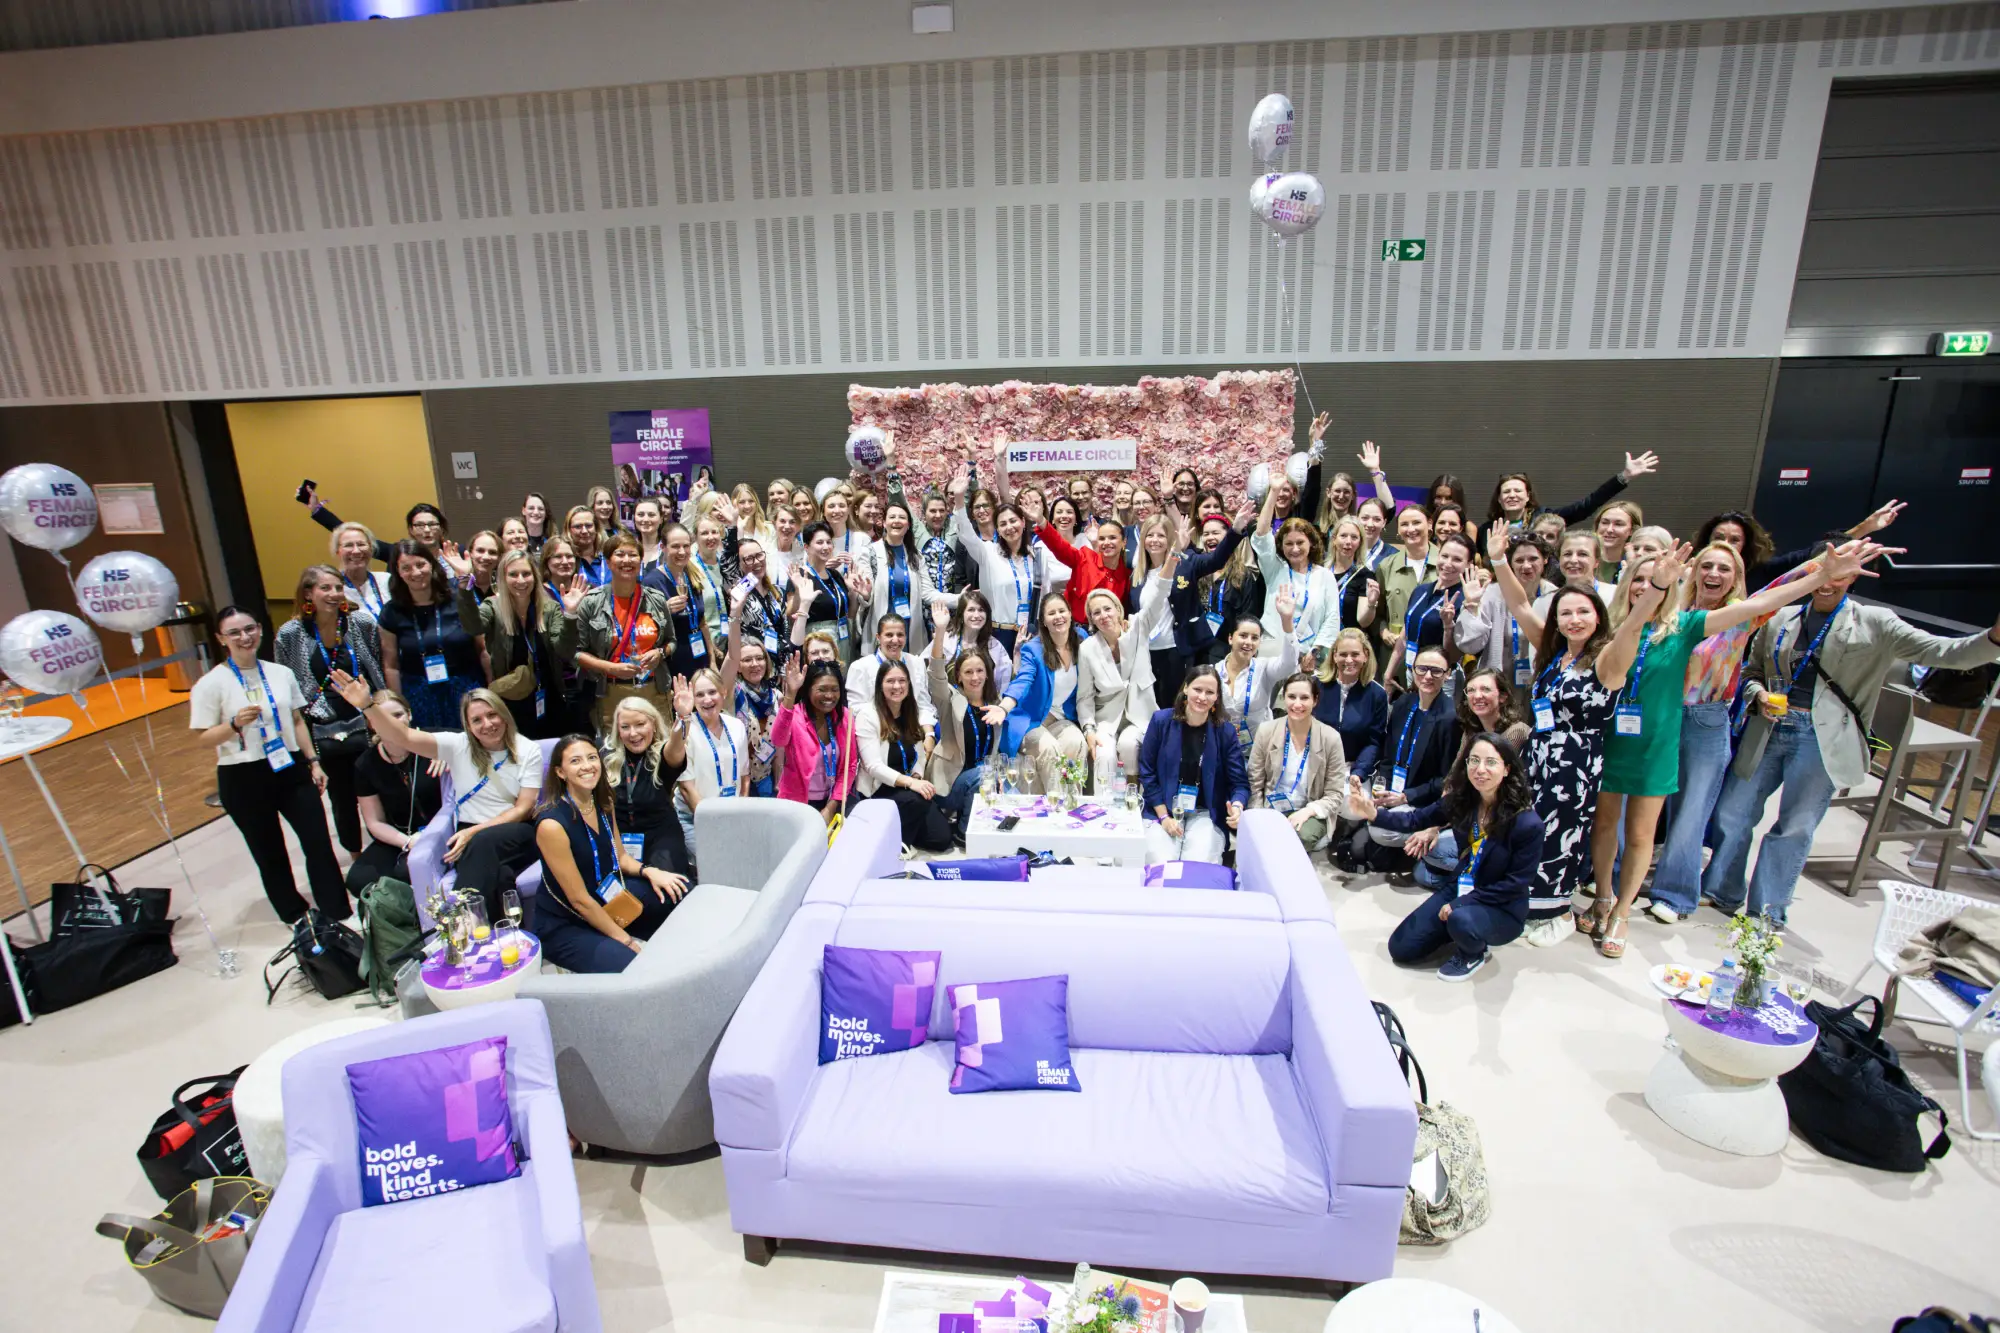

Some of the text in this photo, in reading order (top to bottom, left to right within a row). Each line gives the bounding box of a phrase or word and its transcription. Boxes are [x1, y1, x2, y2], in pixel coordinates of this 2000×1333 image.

[1272, 198, 1317, 215] FEMALE
[1272, 209, 1315, 224] CIRCLE
[636, 428, 684, 440] FEMALE
[640, 440, 682, 451] CIRCLE
[1030, 450, 1083, 461] FEMALE
[1085, 449, 1133, 461] CIRCLE
[456, 461, 473, 470] WC
[34, 514, 97, 528] CIRCLE
[83, 584, 159, 600] FEMALE
[90, 598, 159, 612] CIRCLE
[42, 645, 99, 674] CIRCLE
[829, 1013, 868, 1030] bold
[828, 1027, 885, 1043] moves.
[836, 1041, 874, 1055] kind
[1037, 1068, 1070, 1077] FEMALE
[1037, 1076, 1068, 1085] CIRCLE
[366, 1140, 416, 1163] bold
[367, 1153, 444, 1177] moves.
[382, 1169, 431, 1192] kind
[384, 1177, 465, 1202] hearts.
